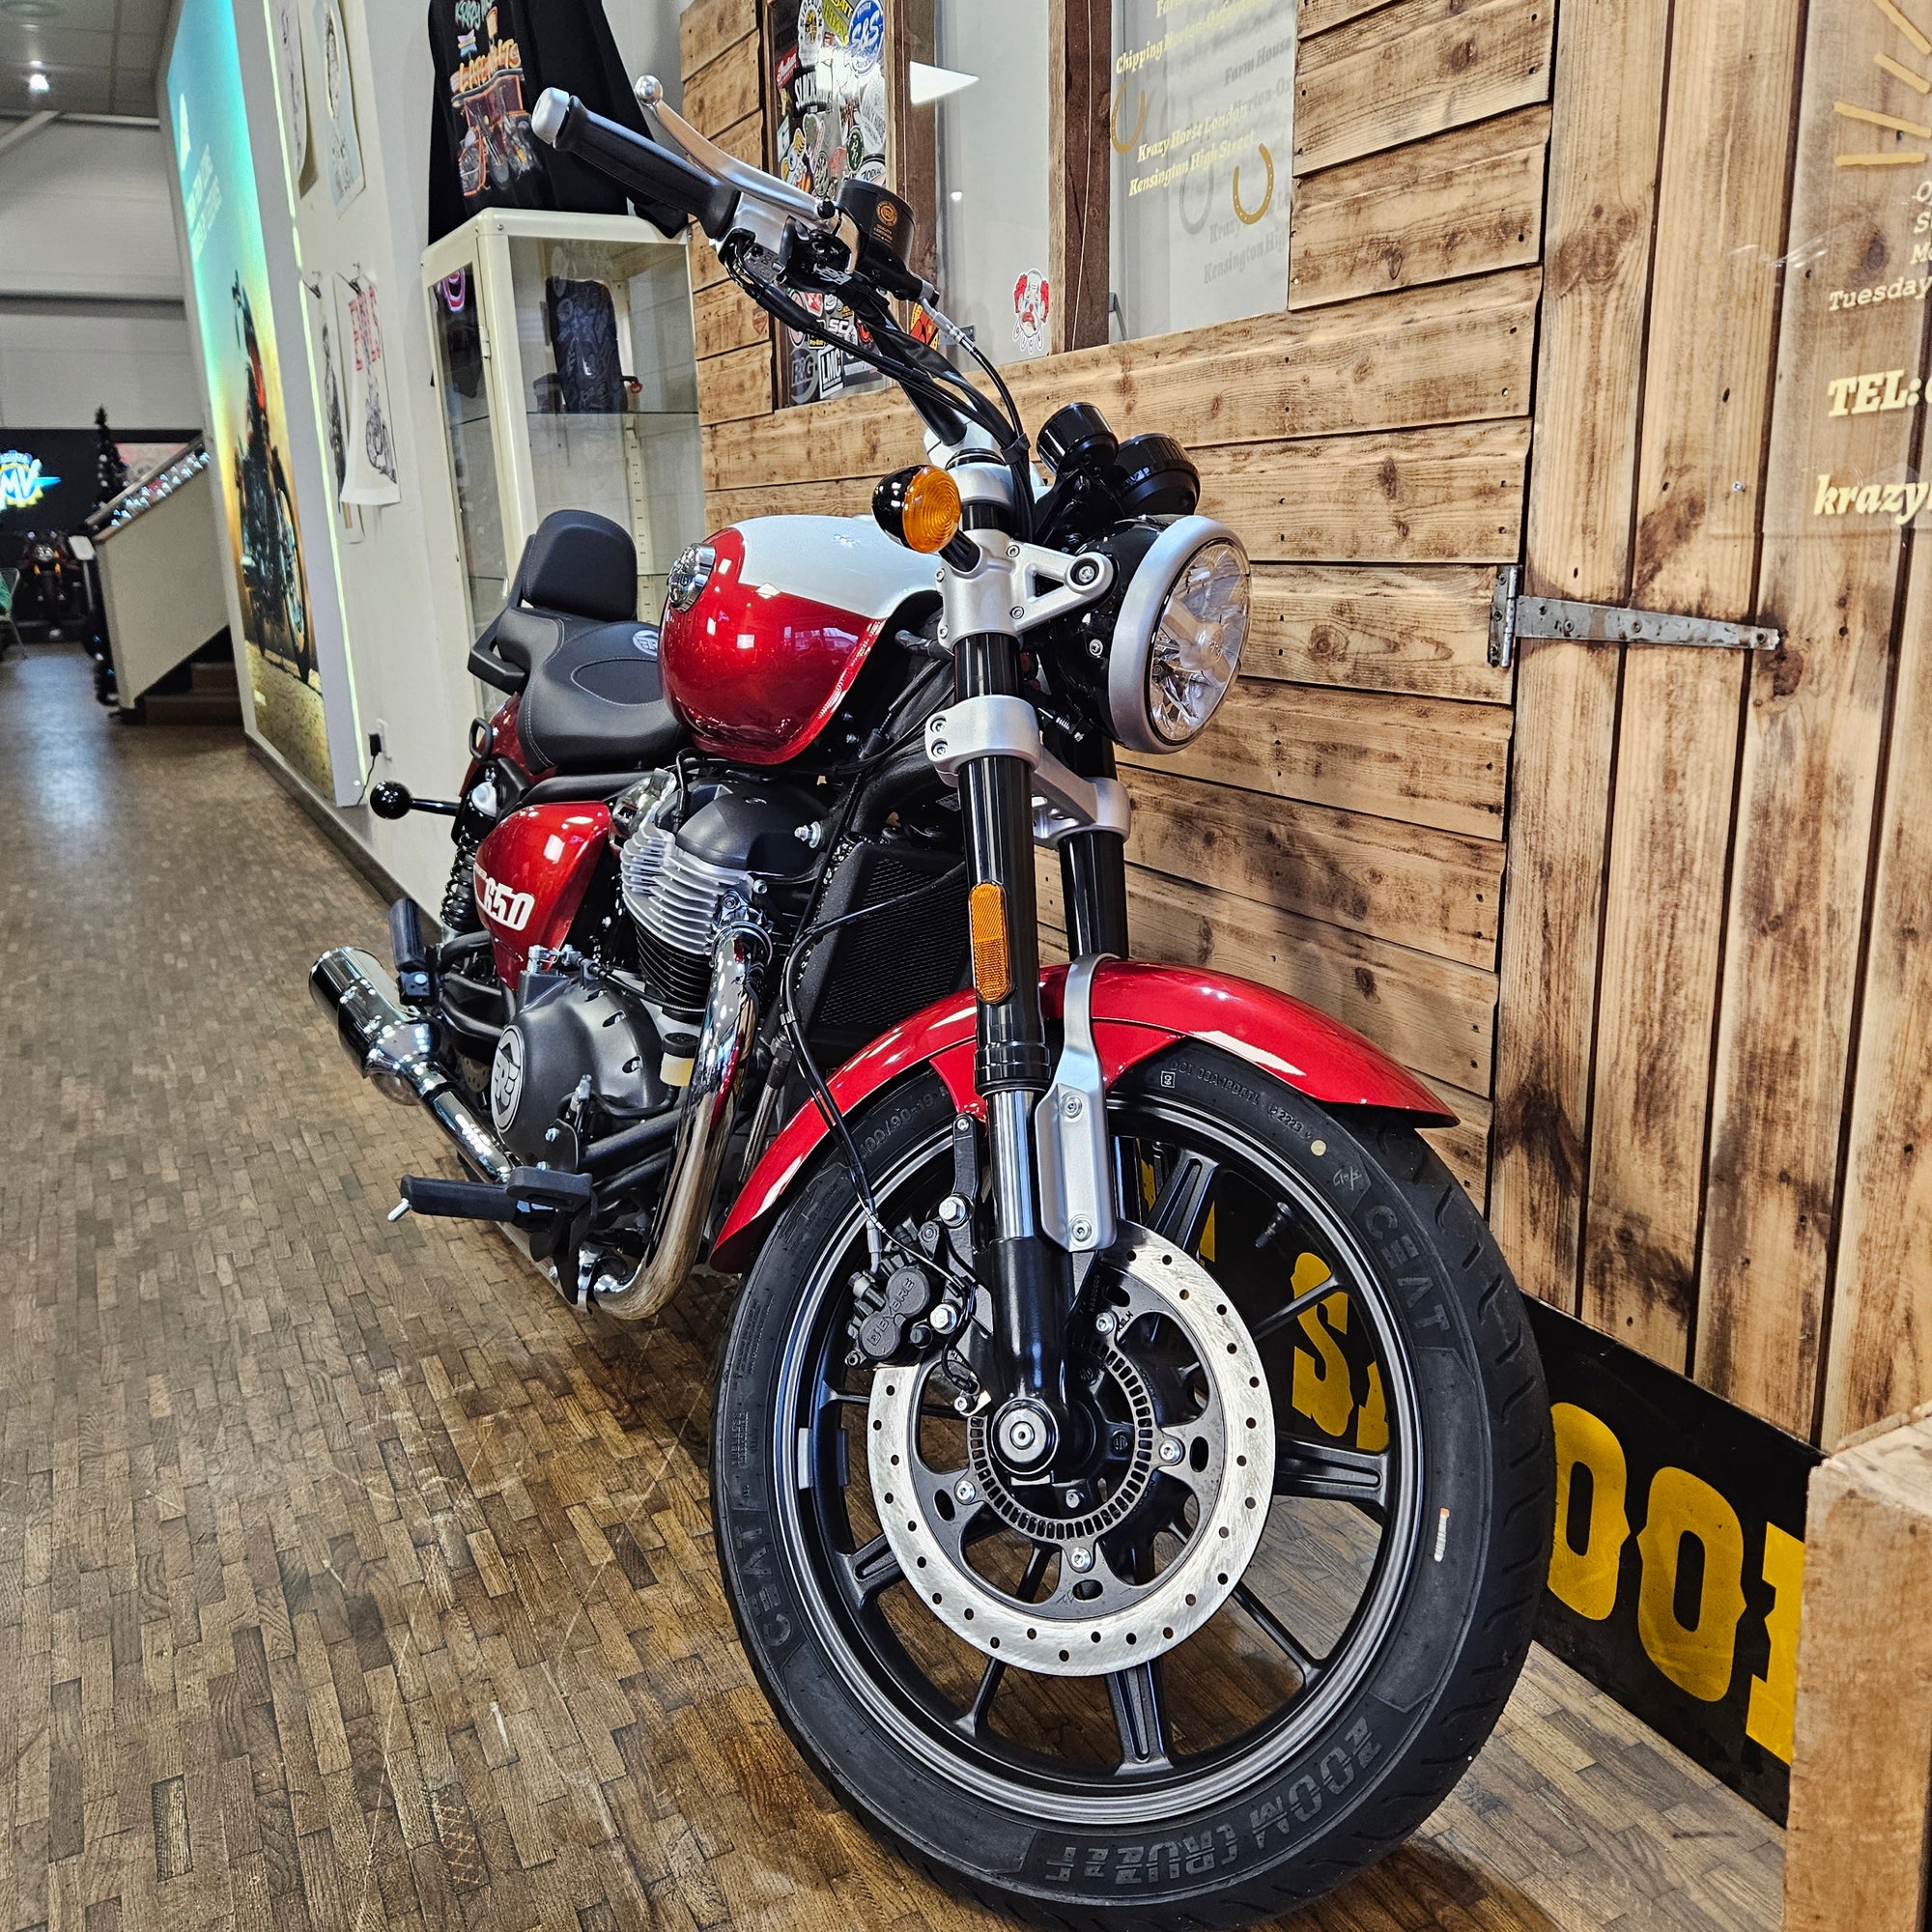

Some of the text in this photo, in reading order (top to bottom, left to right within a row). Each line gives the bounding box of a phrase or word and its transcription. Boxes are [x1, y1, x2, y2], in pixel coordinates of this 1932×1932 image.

[1115, 40, 1164, 75] Chipping
[1137, 138, 1170, 163] Krazy
[1128, 158, 1189, 197] Kensington
[1829, 275, 1932, 311] Tuesday
[1813, 473, 1932, 526] krazy
[484, 876, 535, 931] 650
[1365, 1205, 1451, 1331] CEAT
[735, 1526, 792, 1647] CEAT
[1251, 1717, 1383, 1849] ZOOM
